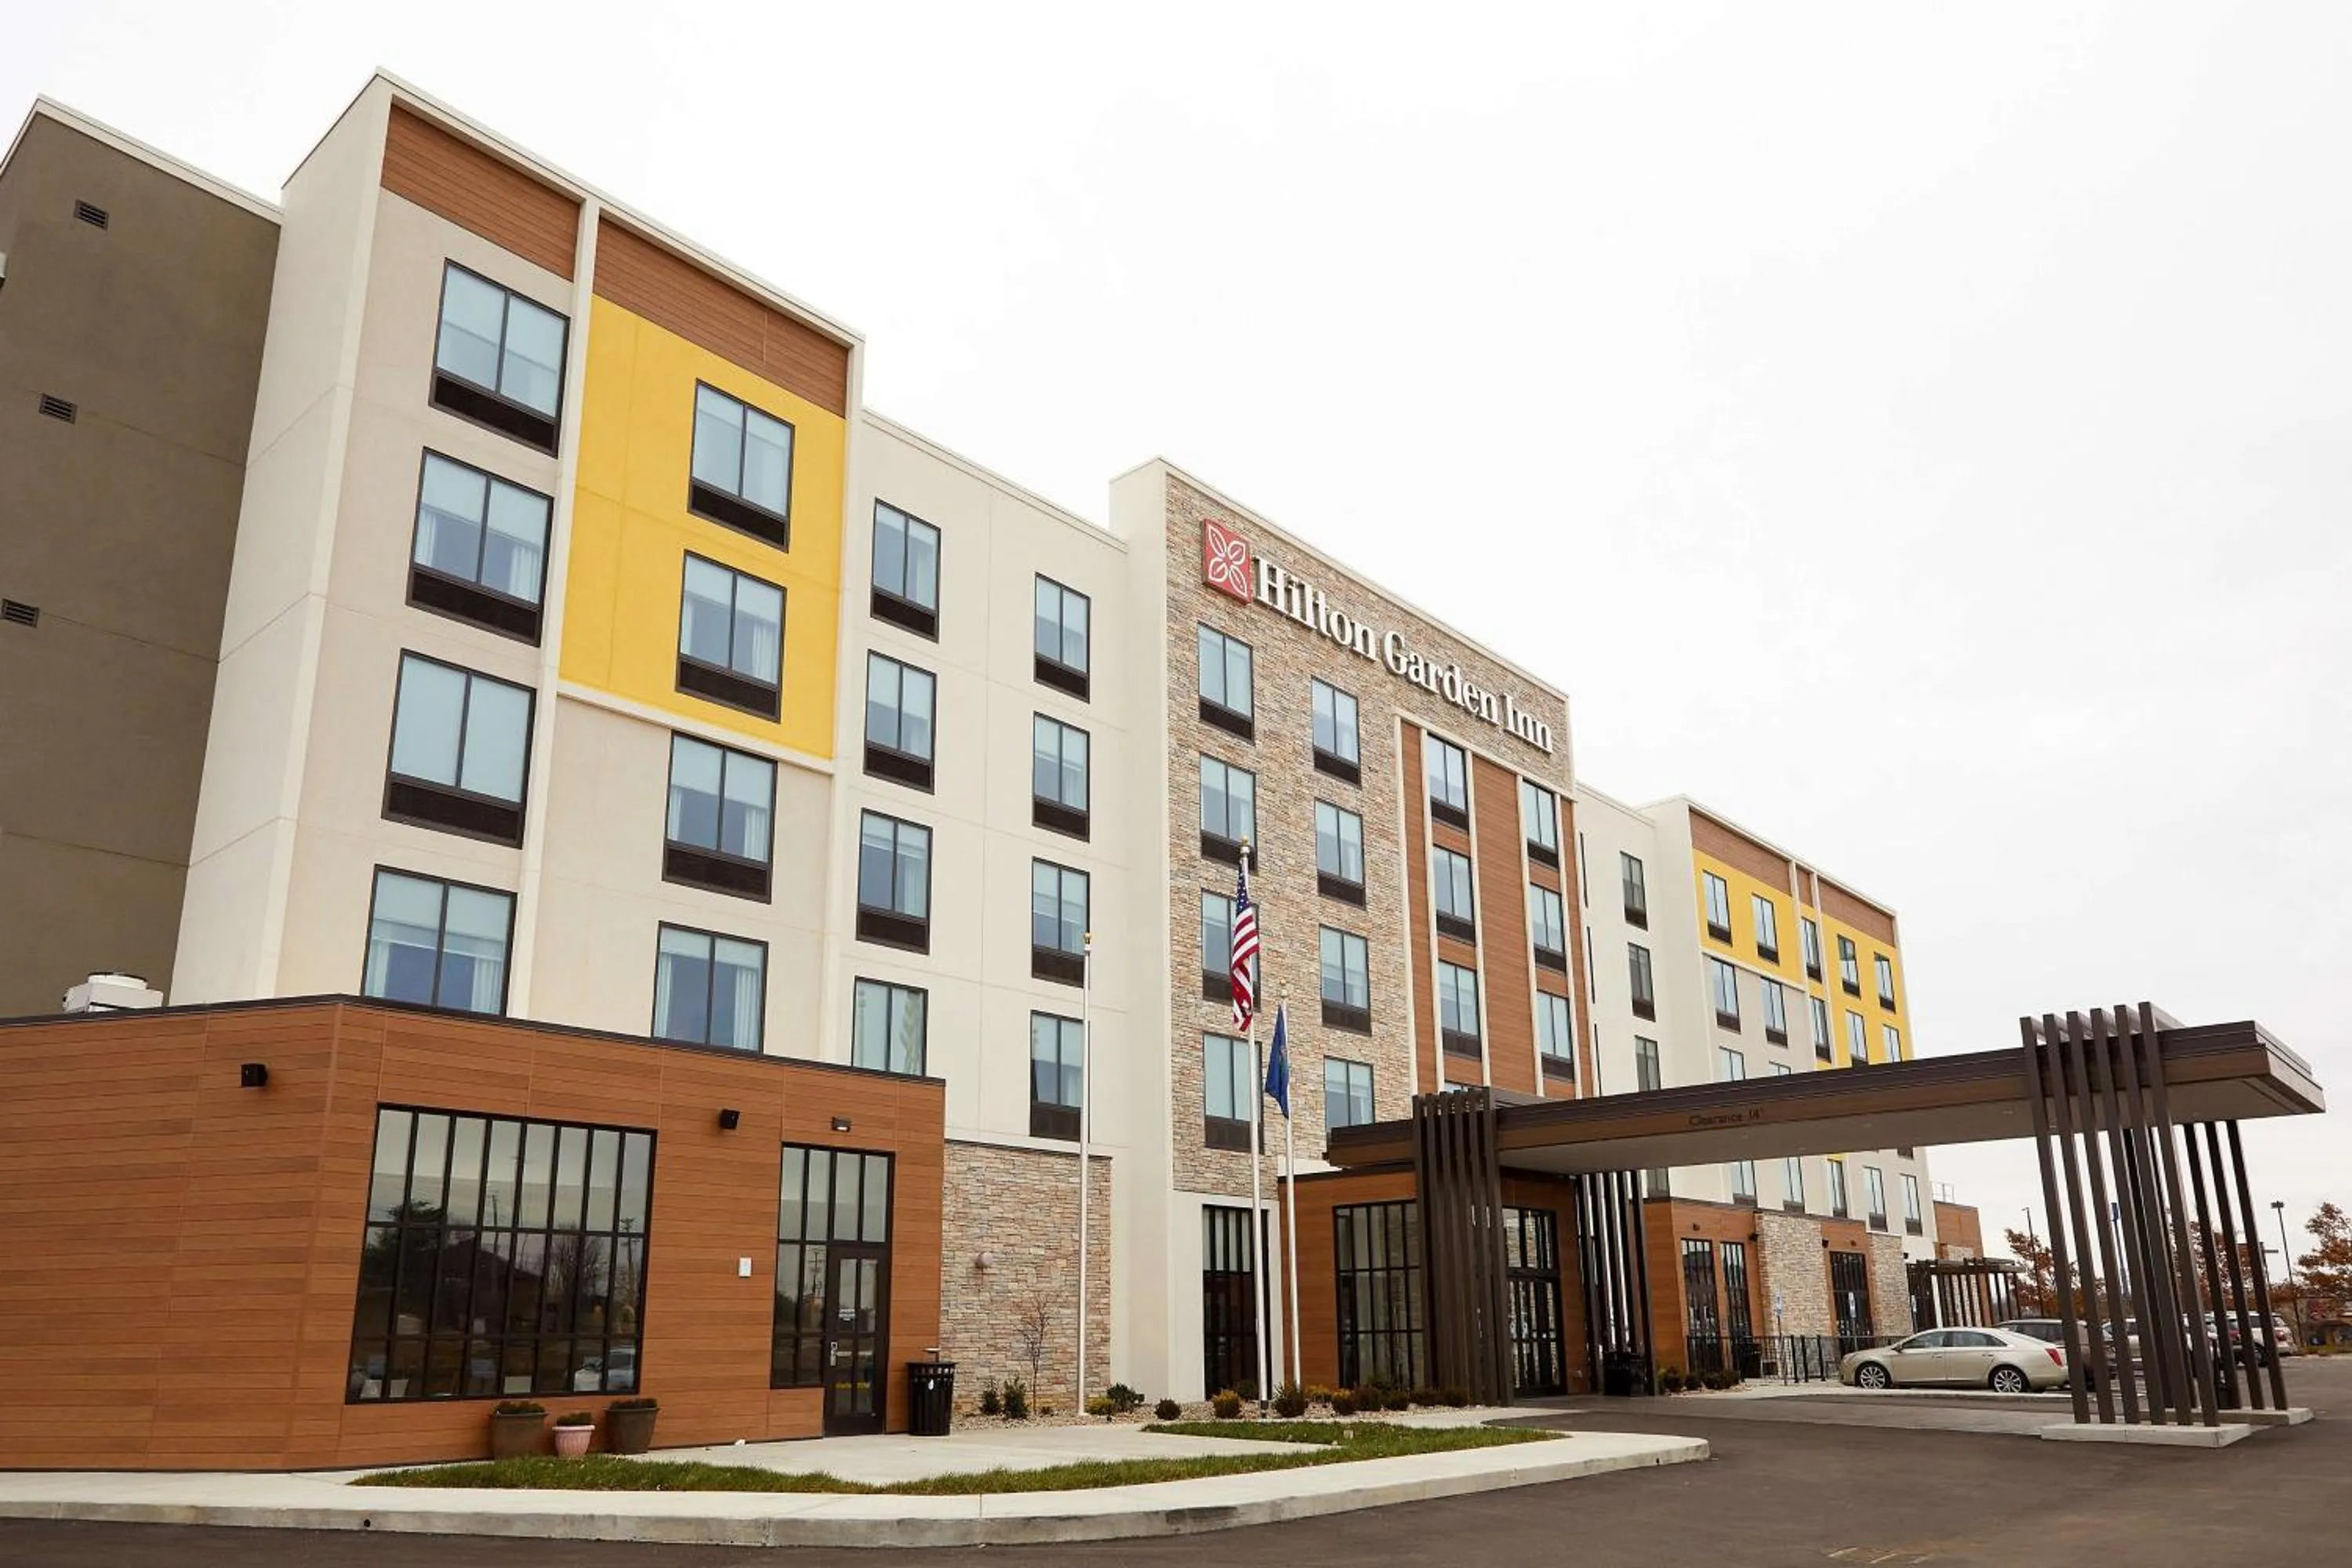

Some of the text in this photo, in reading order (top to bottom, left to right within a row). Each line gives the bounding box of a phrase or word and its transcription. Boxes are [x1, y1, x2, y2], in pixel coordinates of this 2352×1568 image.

[1254, 556, 1553, 753] Hilton Garden Inn
[1689, 1113, 1742, 1127] Clearance
